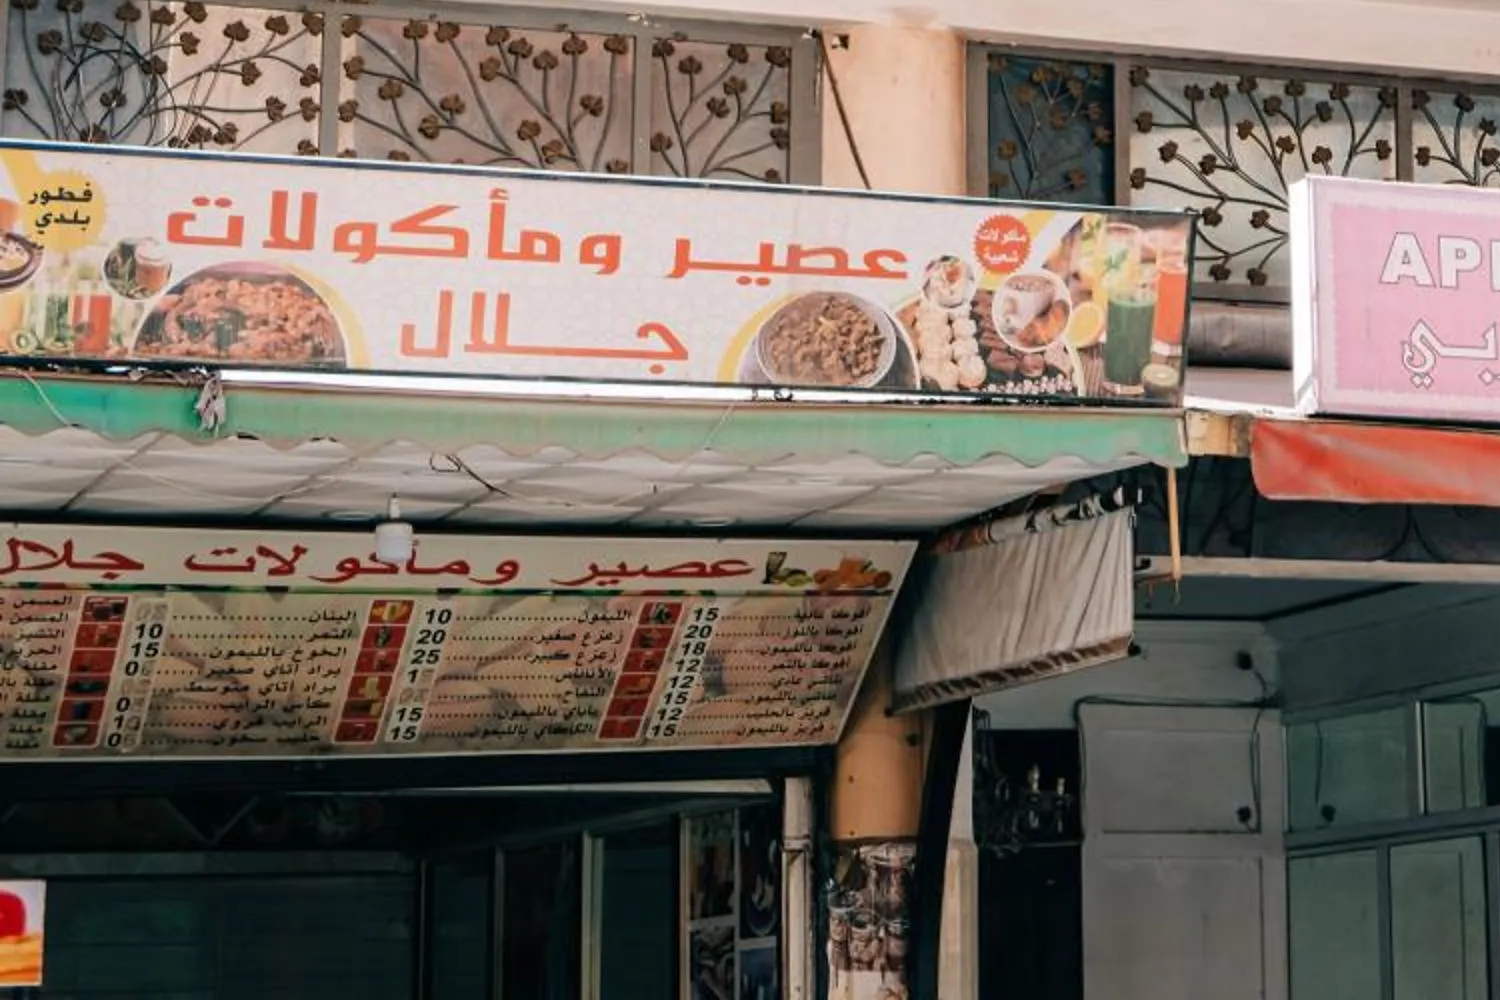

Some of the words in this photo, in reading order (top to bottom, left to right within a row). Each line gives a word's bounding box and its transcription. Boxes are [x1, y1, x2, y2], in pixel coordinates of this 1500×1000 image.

[28, 181, 93, 205] فطور
[35, 208, 91, 234] بلدي
[166, 187, 622, 276] ومأكولات
[665, 237, 909, 286] عصير
[400, 290, 689, 375] جلال
[0, 537, 145, 580] جلال
[550, 558, 754, 587] عصير
[425, 608, 453, 624] 10
[693, 607, 719, 621] 15
[135, 623, 164, 639] 10
[416, 629, 446, 645] 20
[684, 624, 713, 639] 20
[130, 642, 160, 658] 15
[681, 641, 707, 656] 18
[410, 649, 441, 665] 25
[675, 659, 700, 673] 12
[669, 675, 695, 689] 12
[663, 691, 688, 705] 15
[395, 707, 424, 722] 15
[657, 707, 683, 721] 12
[390, 725, 417, 741] 15
[651, 723, 677, 737] 15
